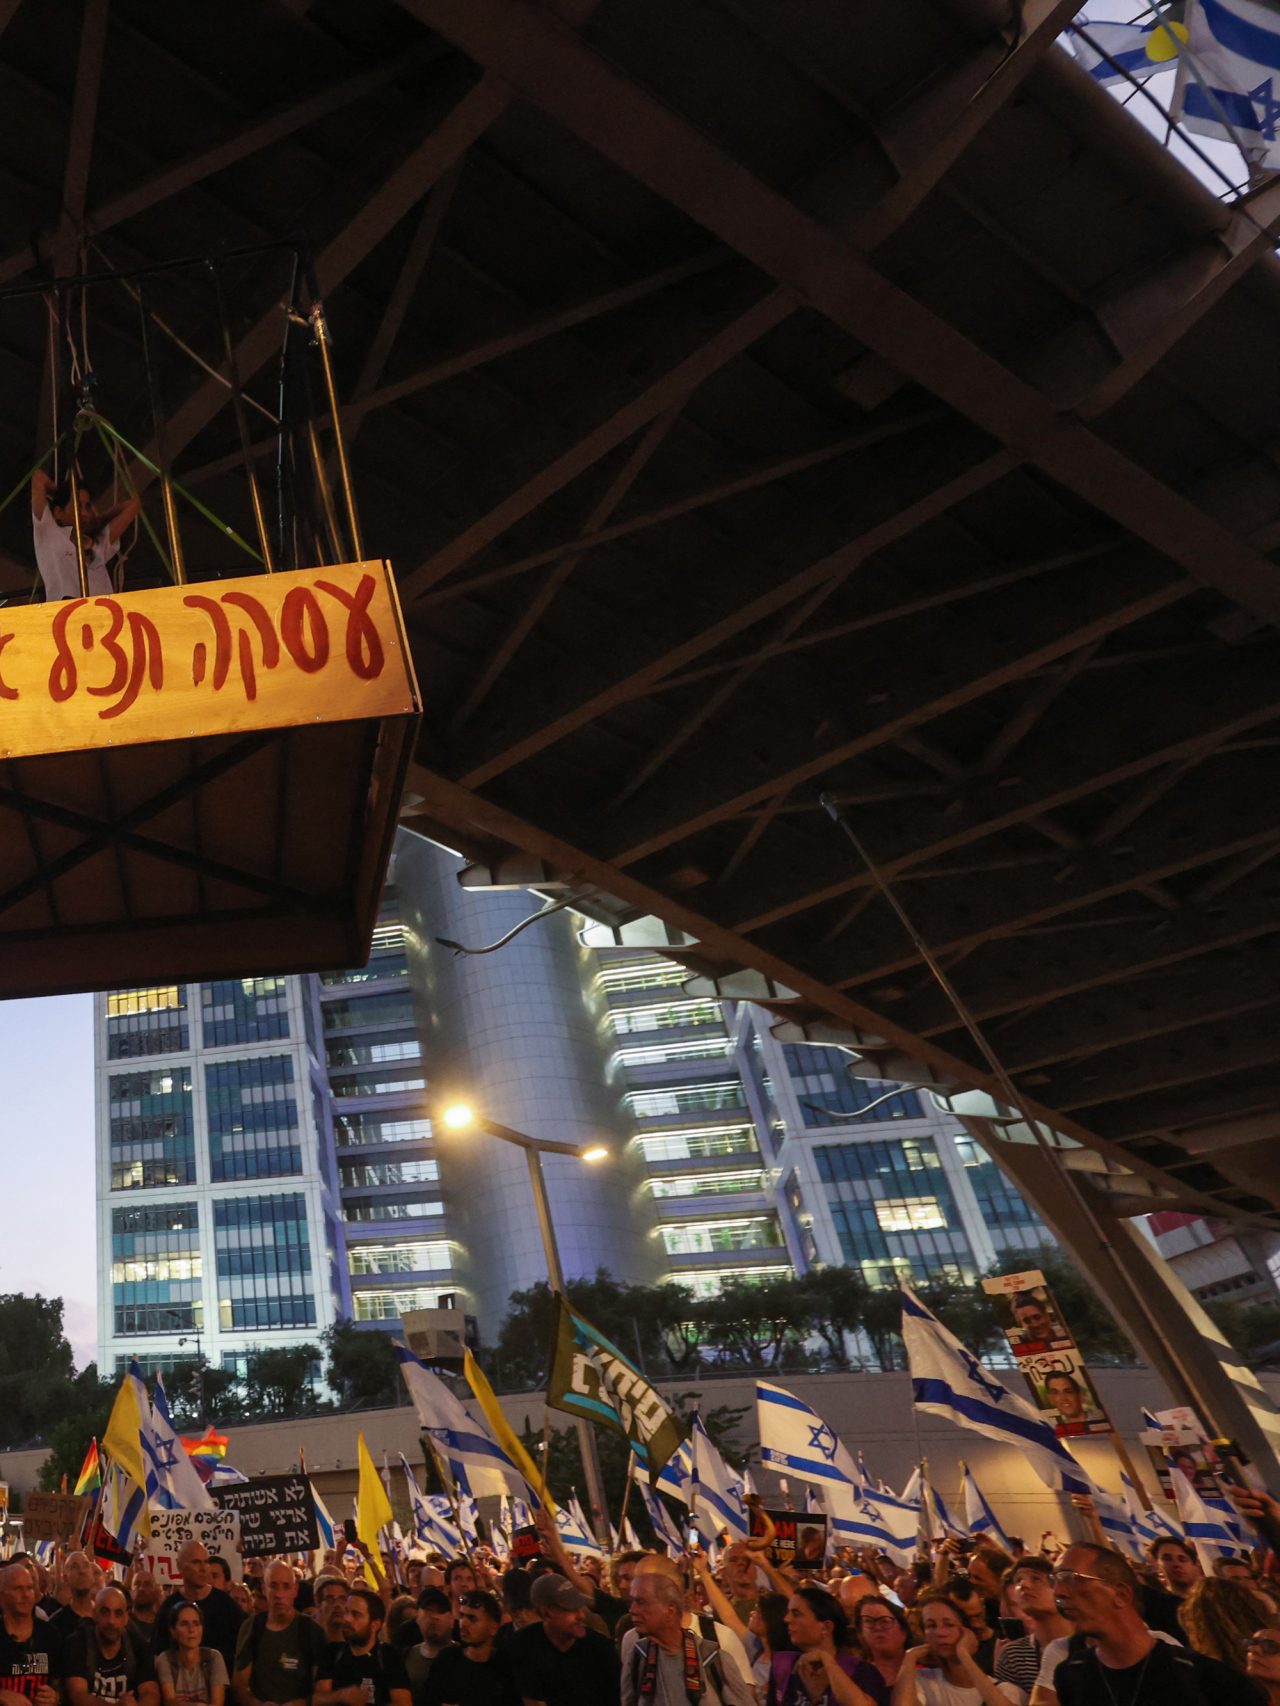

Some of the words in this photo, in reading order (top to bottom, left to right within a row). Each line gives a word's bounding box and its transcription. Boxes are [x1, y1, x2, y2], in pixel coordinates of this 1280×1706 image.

[182, 574, 384, 701] עסקה
[48, 597, 164, 719] תציל
[223, 1488, 278, 1510] אשתוק
[284, 1479, 305, 1502] לא
[150, 1511, 192, 1528] מפונים
[270, 1507, 308, 1525] ארצי
[151, 1527, 193, 1540] פליטים
[201, 1525, 234, 1540] חיילים
[243, 1533, 276, 1549] פניה
[285, 1529, 310, 1547] את
